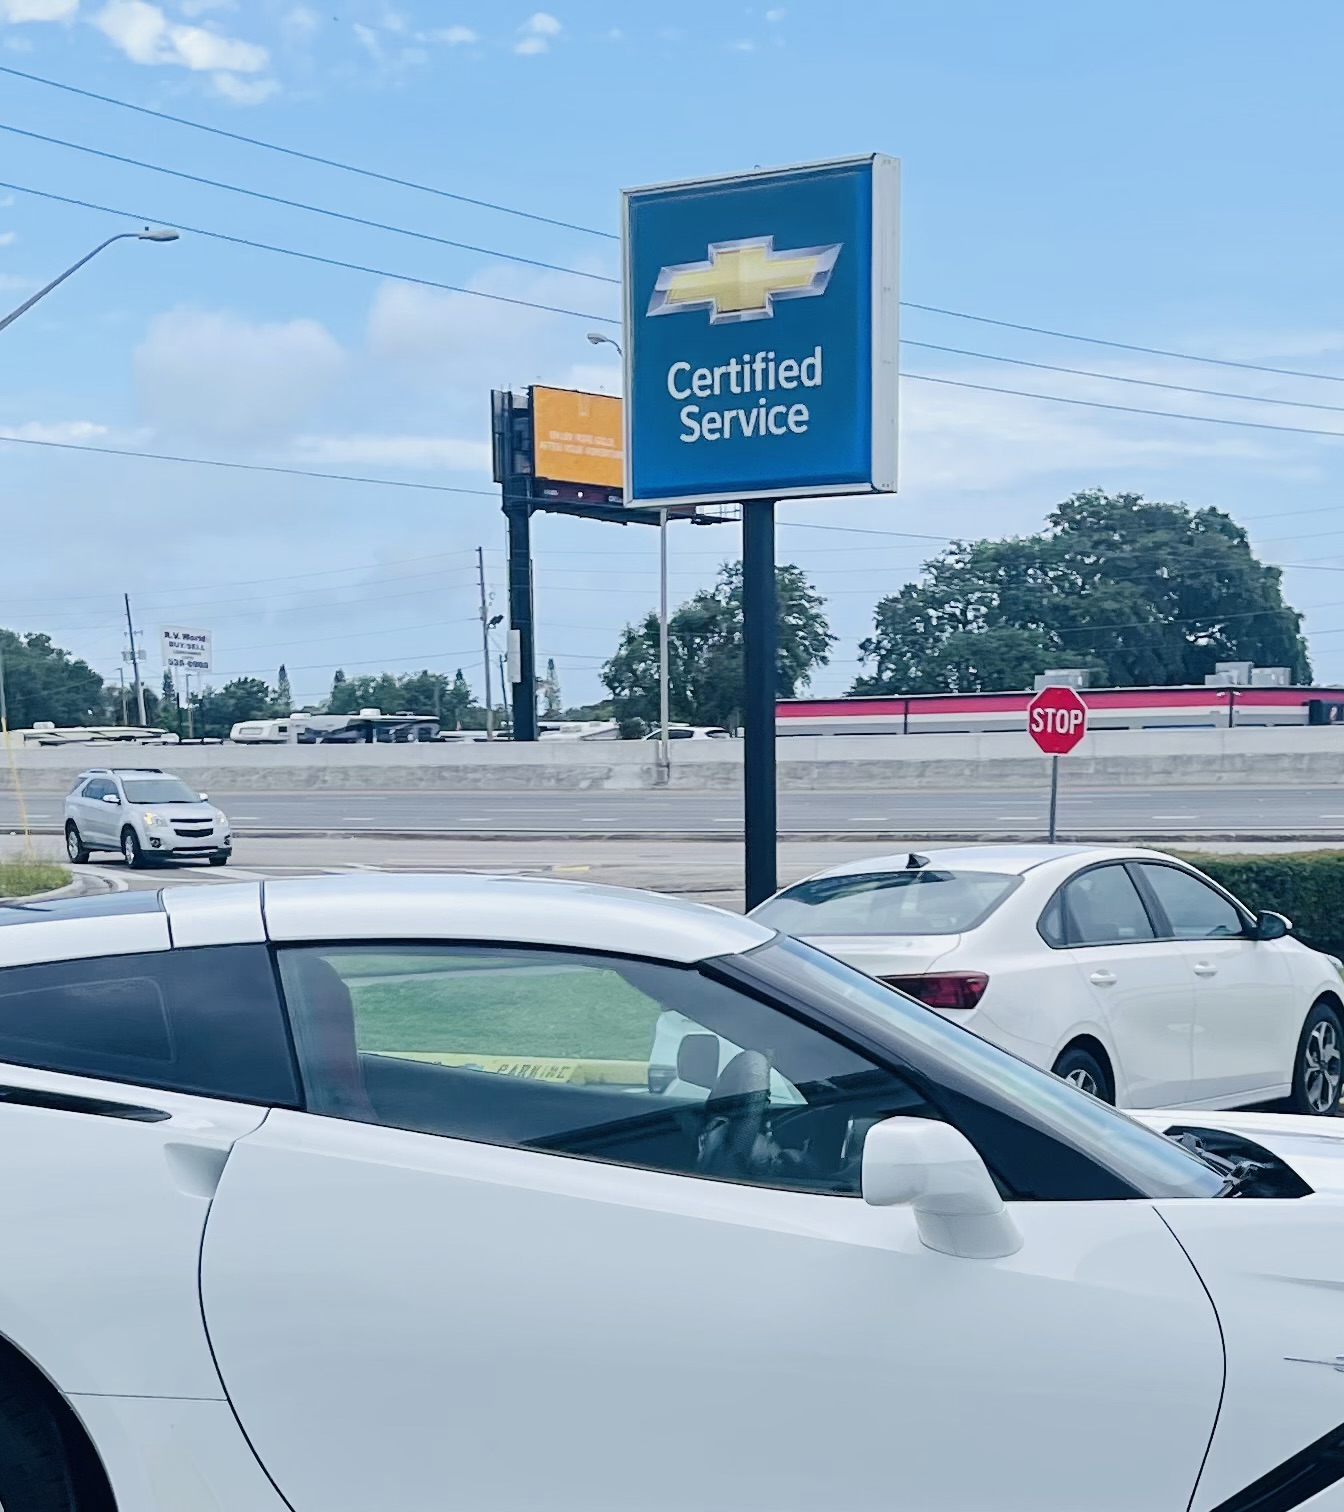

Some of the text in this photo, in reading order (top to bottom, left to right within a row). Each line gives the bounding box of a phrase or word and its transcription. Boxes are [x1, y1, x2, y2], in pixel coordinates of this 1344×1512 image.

[667, 345, 823, 400] Certified
[679, 397, 809, 443] Service
[1031, 707, 1083, 735] STOP
